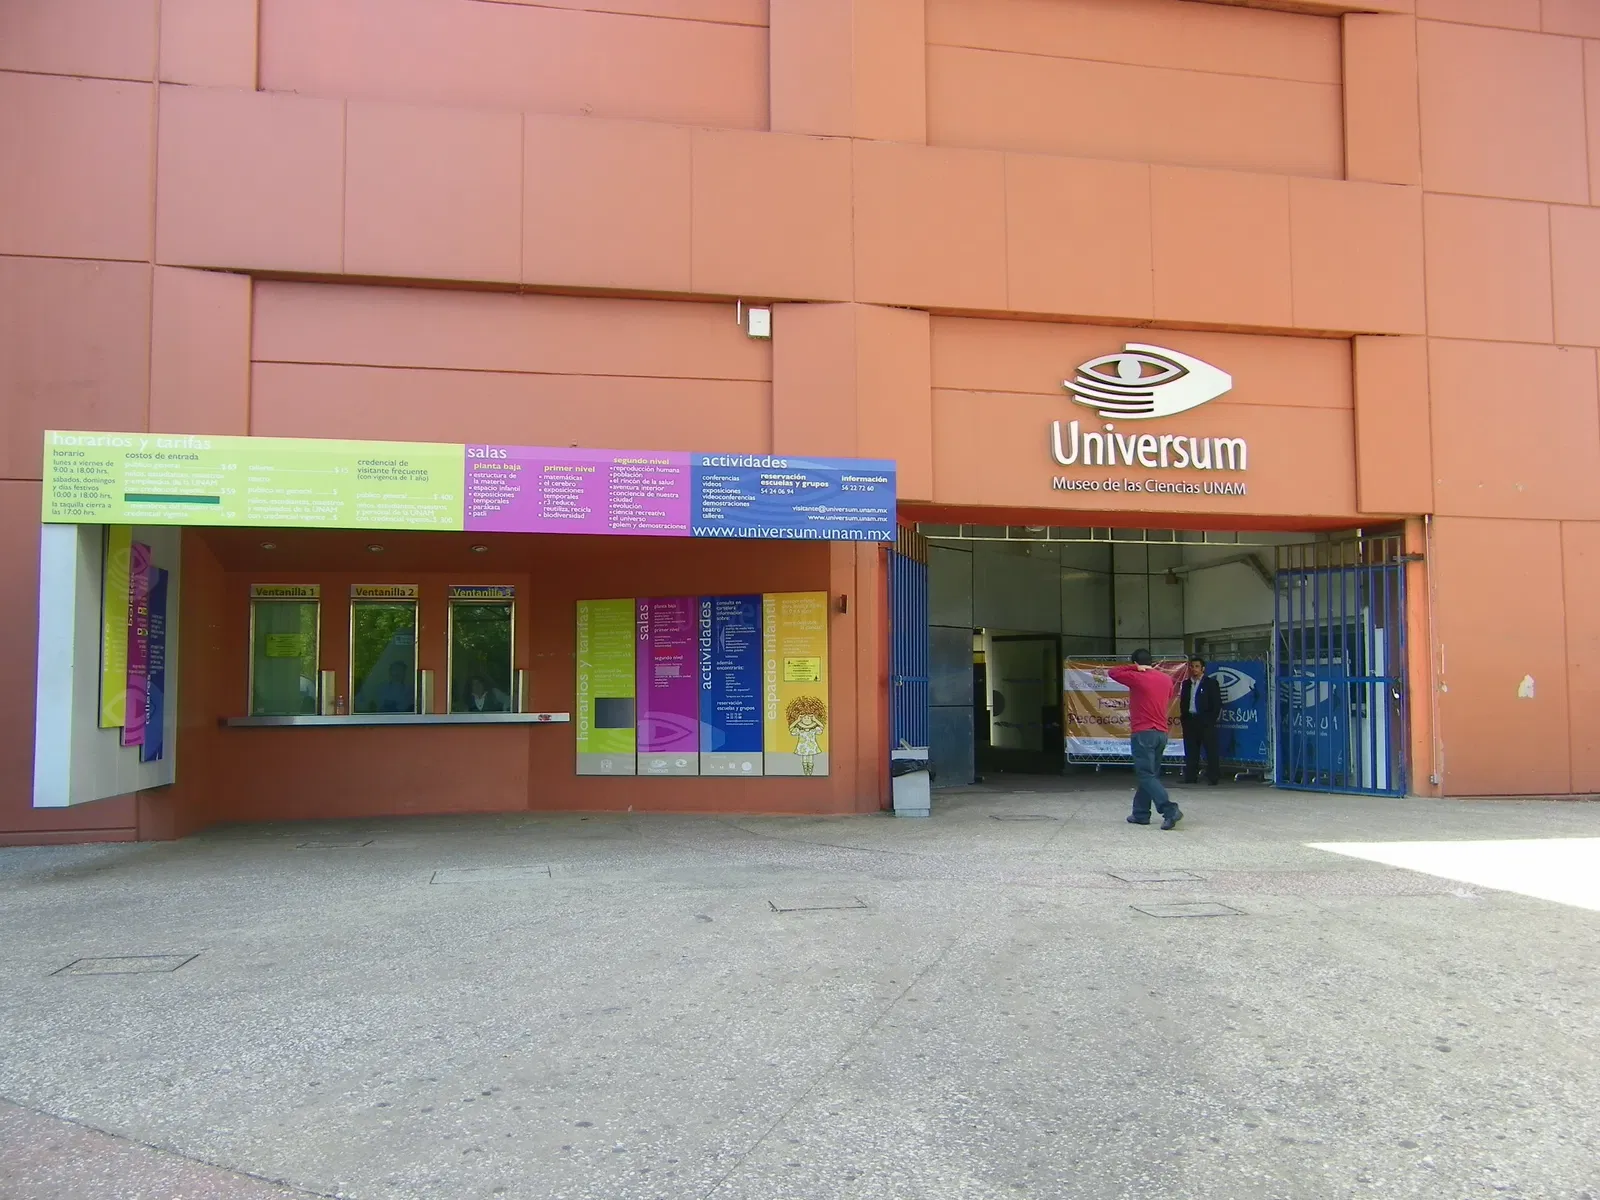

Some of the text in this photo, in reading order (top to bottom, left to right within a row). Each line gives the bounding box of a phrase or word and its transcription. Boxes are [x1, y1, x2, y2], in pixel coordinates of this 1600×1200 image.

[52, 432, 211, 452] horarios y tarifas
[1053, 420, 1246, 470] Universum
[468, 445, 507, 459] salas
[544, 465, 573, 473] primer
[613, 457, 647, 466] segundo
[702, 455, 787, 469] actividades
[1053, 477, 1245, 495] Museo de las Ciencias UNAM
[792, 505, 888, 514] visitante@universum.unam.mx
[693, 525, 891, 540] www.universum.unam.mx
[256, 587, 306, 596] Ventanilla
[356, 588, 414, 596] Ventanilla 2
[453, 588, 502, 597] Ventanilla
[637, 604, 649, 640] salas
[577, 606, 588, 656] tarifas
[700, 601, 711, 690] actividades
[764, 599, 780, 720] espacio infantil
[577, 674, 588, 740] horarios
